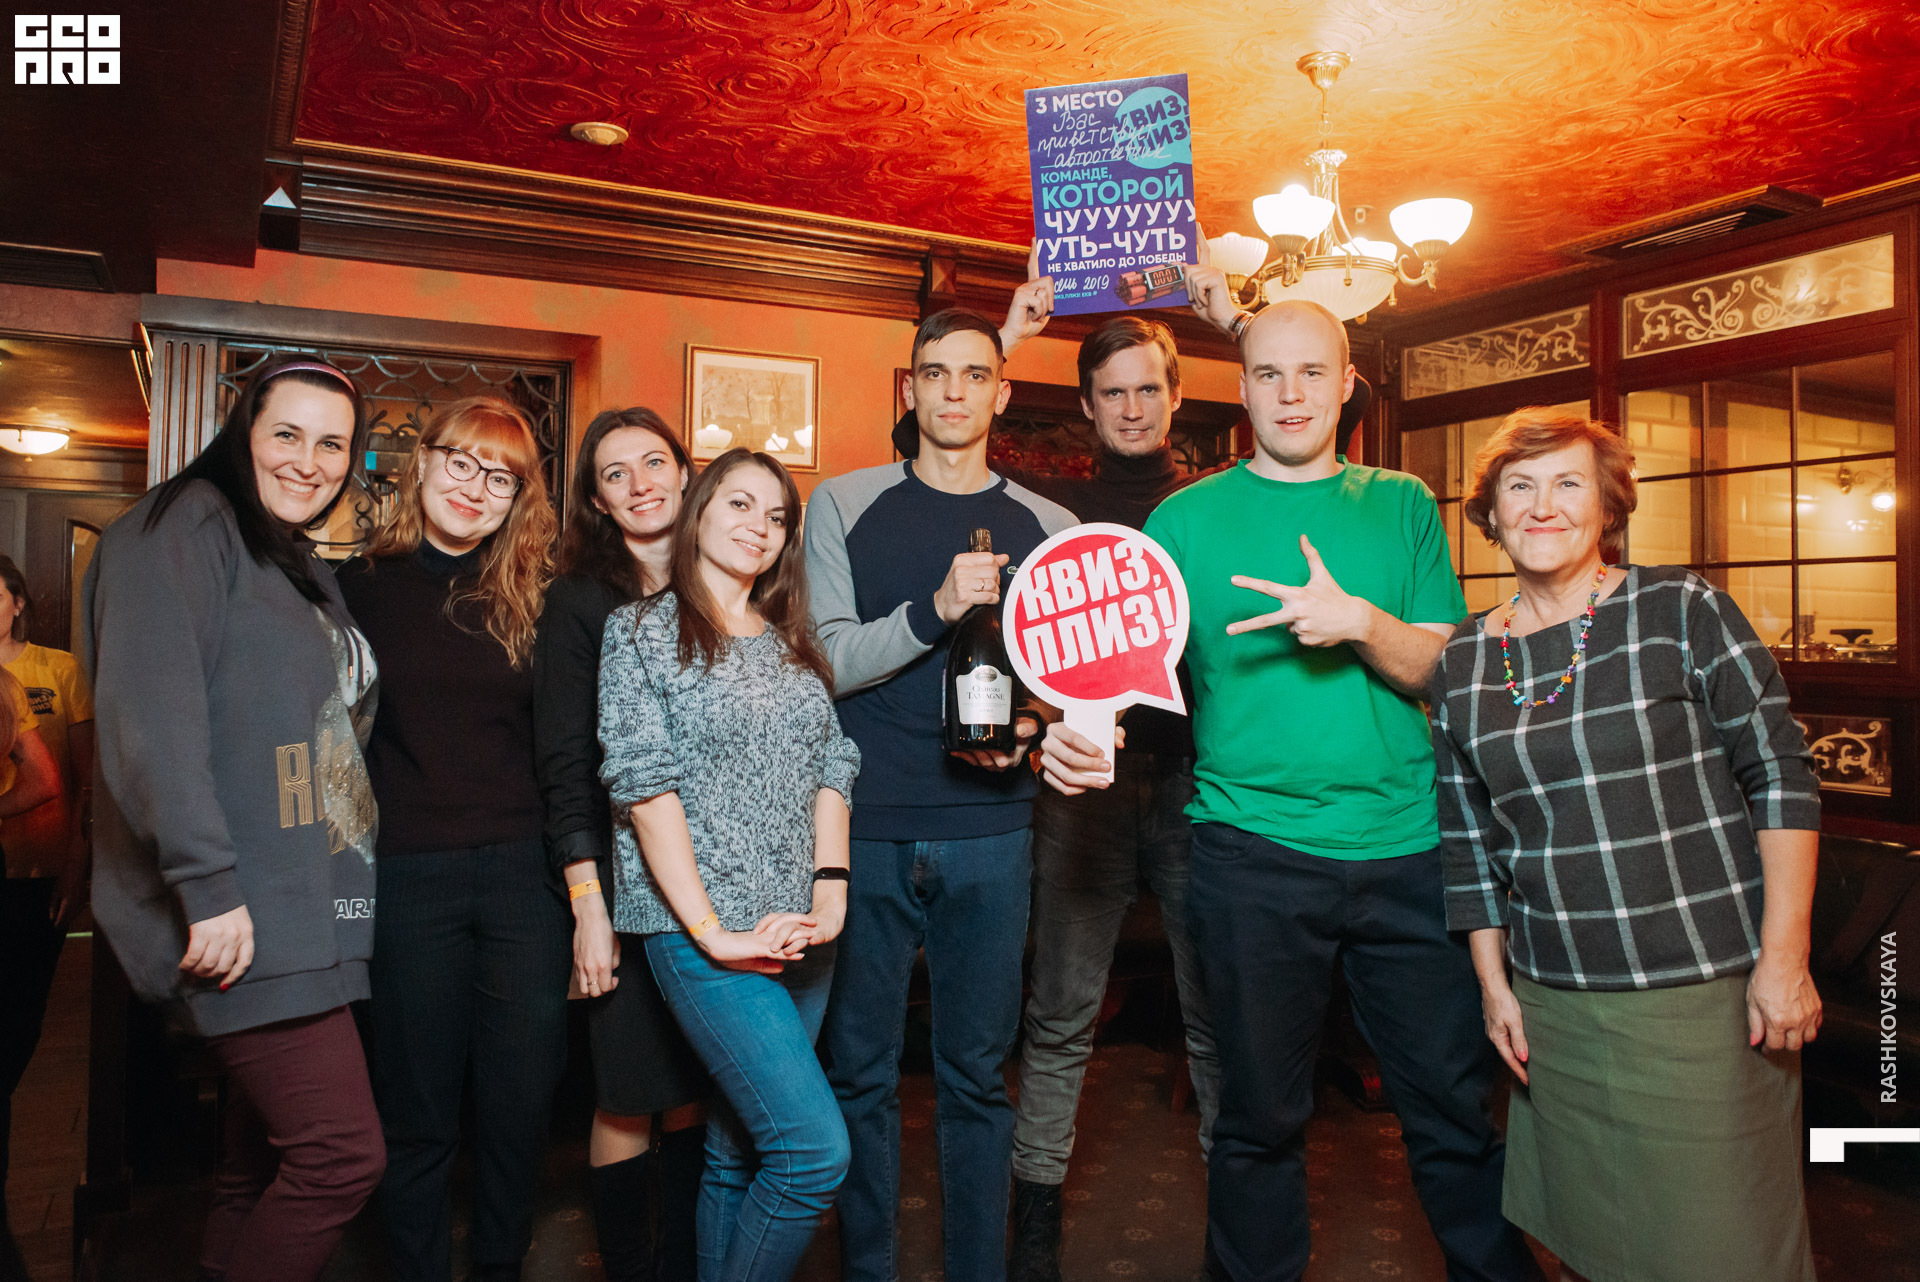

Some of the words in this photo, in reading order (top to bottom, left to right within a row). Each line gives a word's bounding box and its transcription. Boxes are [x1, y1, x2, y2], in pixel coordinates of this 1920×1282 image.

[1035, 97, 1047, 113] 3
[1053, 90, 1123, 112] МЕСТО
[1053, 111, 1101, 132] Вас
[1041, 167, 1112, 184] КОМАНДЕ,
[1042, 169, 1184, 209] КОТОРОЙ
[1048, 263, 1061, 273] НЕ
[1064, 258, 1116, 271] ХВАТИЛО
[1118, 256, 1136, 268] ДО
[1139, 252, 1186, 265] ПОБЕДЫ
[1054, 278, 1077, 293] сень
[1083, 275, 1110, 290] 2019
[1020, 539, 1161, 622] КВИЗ,
[1022, 587, 1176, 677] ПЛИЗ!
[334, 899, 376, 920] AR
